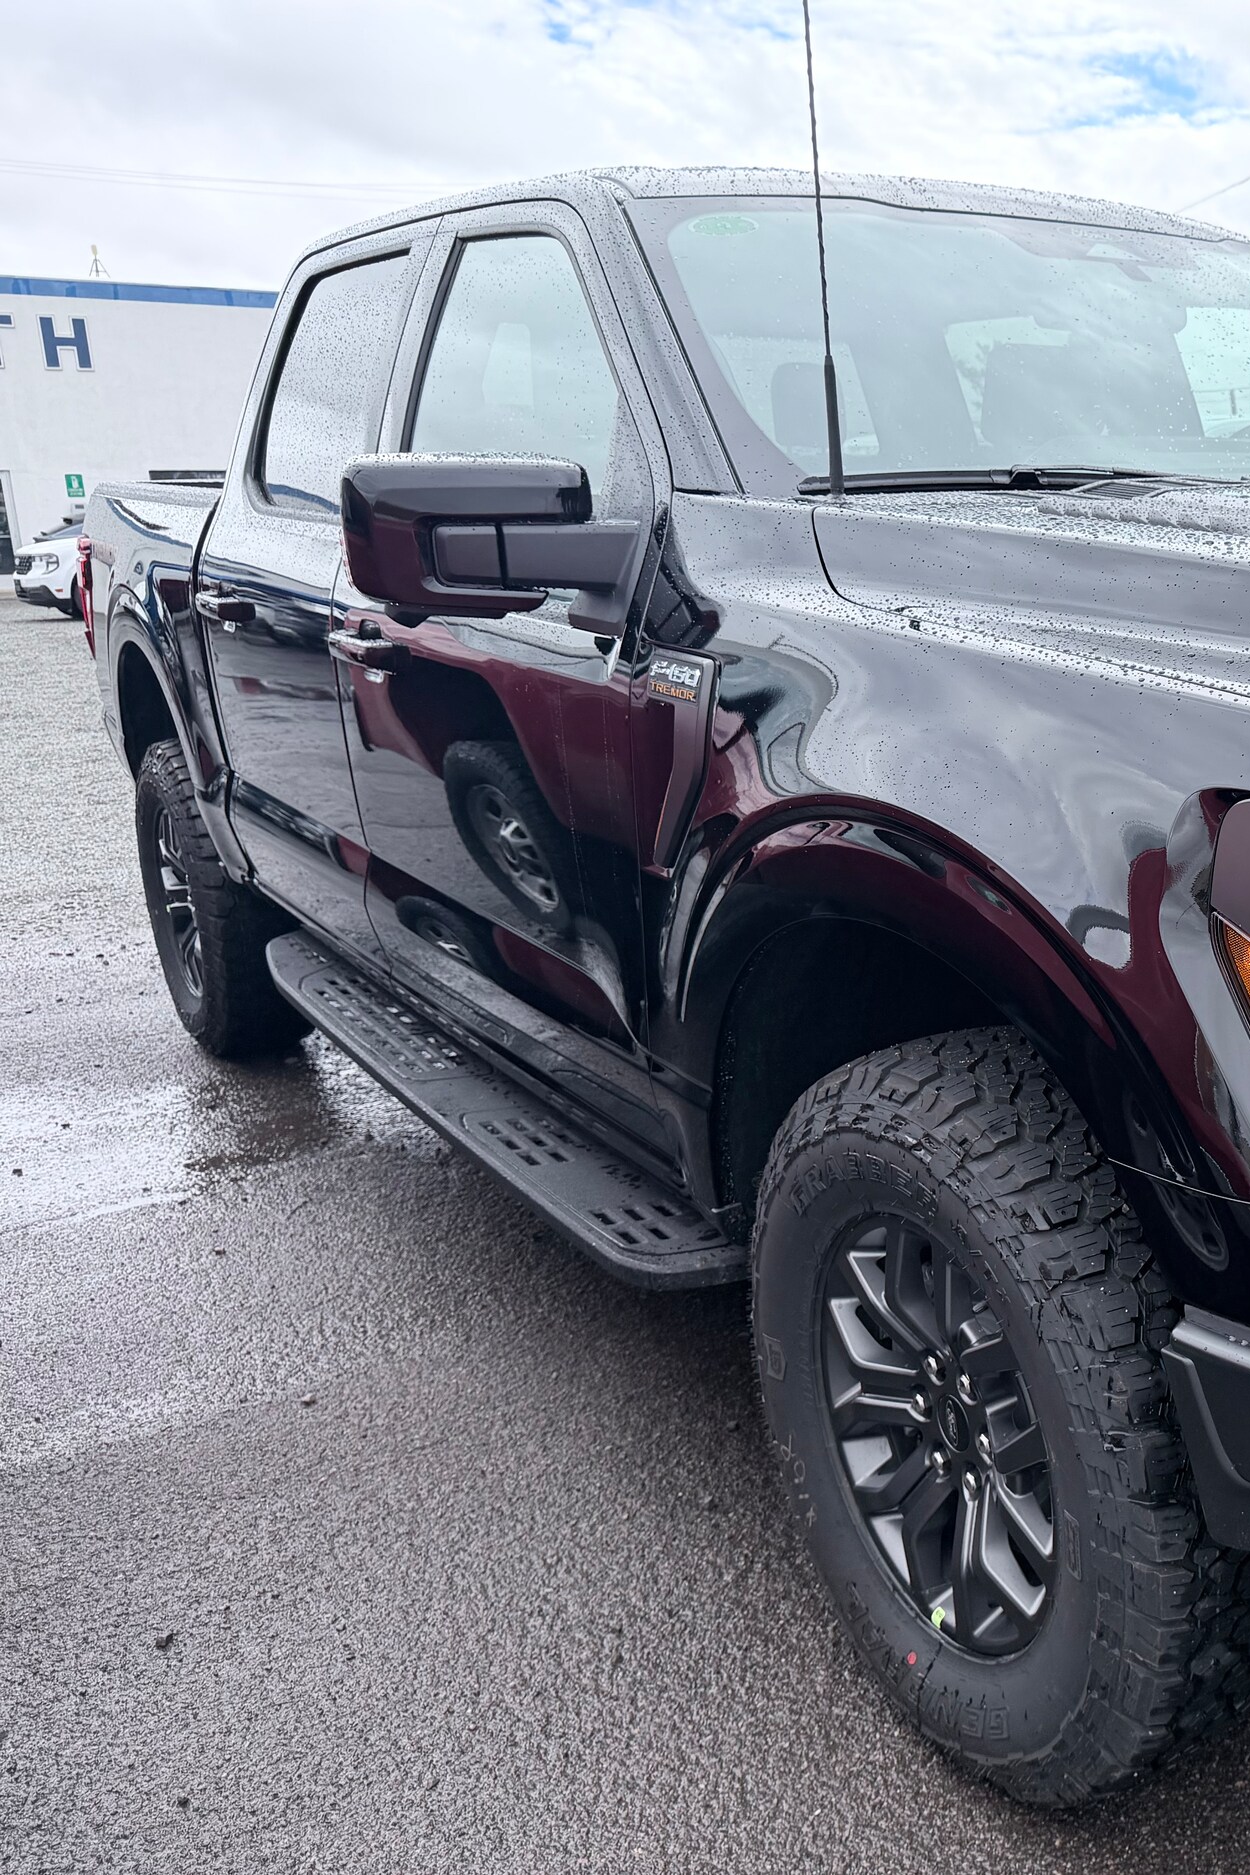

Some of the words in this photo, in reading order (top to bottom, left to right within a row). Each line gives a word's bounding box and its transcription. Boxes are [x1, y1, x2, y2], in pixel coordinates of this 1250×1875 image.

[650, 661, 701, 687] F-150
[651, 682, 696, 702] TREMOR
[790, 1152, 938, 1219] GRABBER
